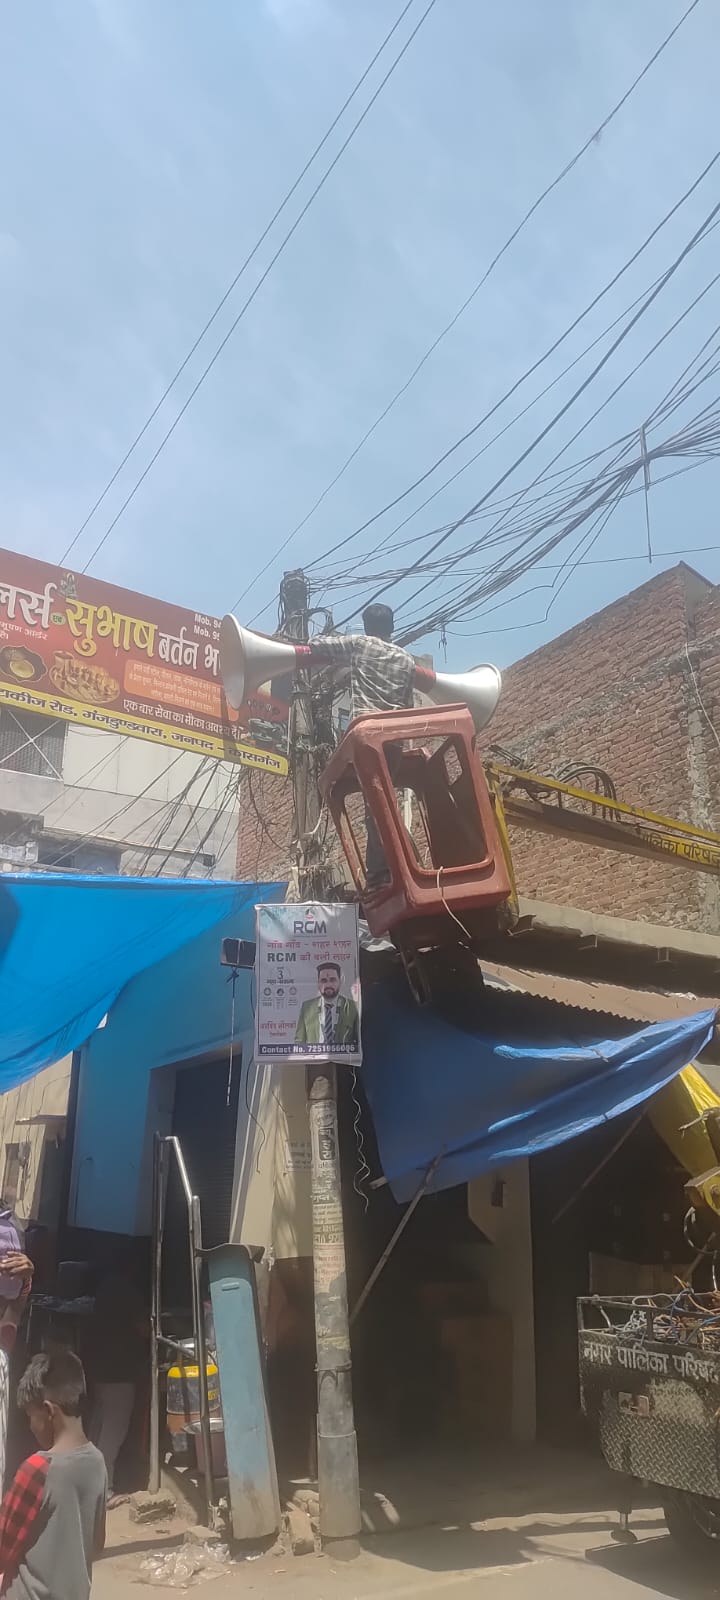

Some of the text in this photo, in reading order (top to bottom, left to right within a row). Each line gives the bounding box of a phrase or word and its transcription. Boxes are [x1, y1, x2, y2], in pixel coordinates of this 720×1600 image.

[194, 613, 212, 627] Mob.
[65, 598, 158, 657] सुभाष
[159, 626, 199, 670] बर्तन
[204, 644, 221, 676] भ
[193, 625, 211, 638] Mob.
[124, 699, 138, 713] एक
[138, 702, 155, 717] बार
[155, 704, 172, 721] सेवा
[172, 711, 185, 724] का
[171, 732, 214, 750] जनपद
[228, 749, 281, 769] कासगंज
[294, 921, 327, 934] RCM
[267, 953, 296, 962] RCM
[261, 1046, 291, 1054] Contact
[293, 1045, 306, 1053] No.
[583, 1340, 613, 1365] नगर
[616, 1343, 669, 1372] पालिका
